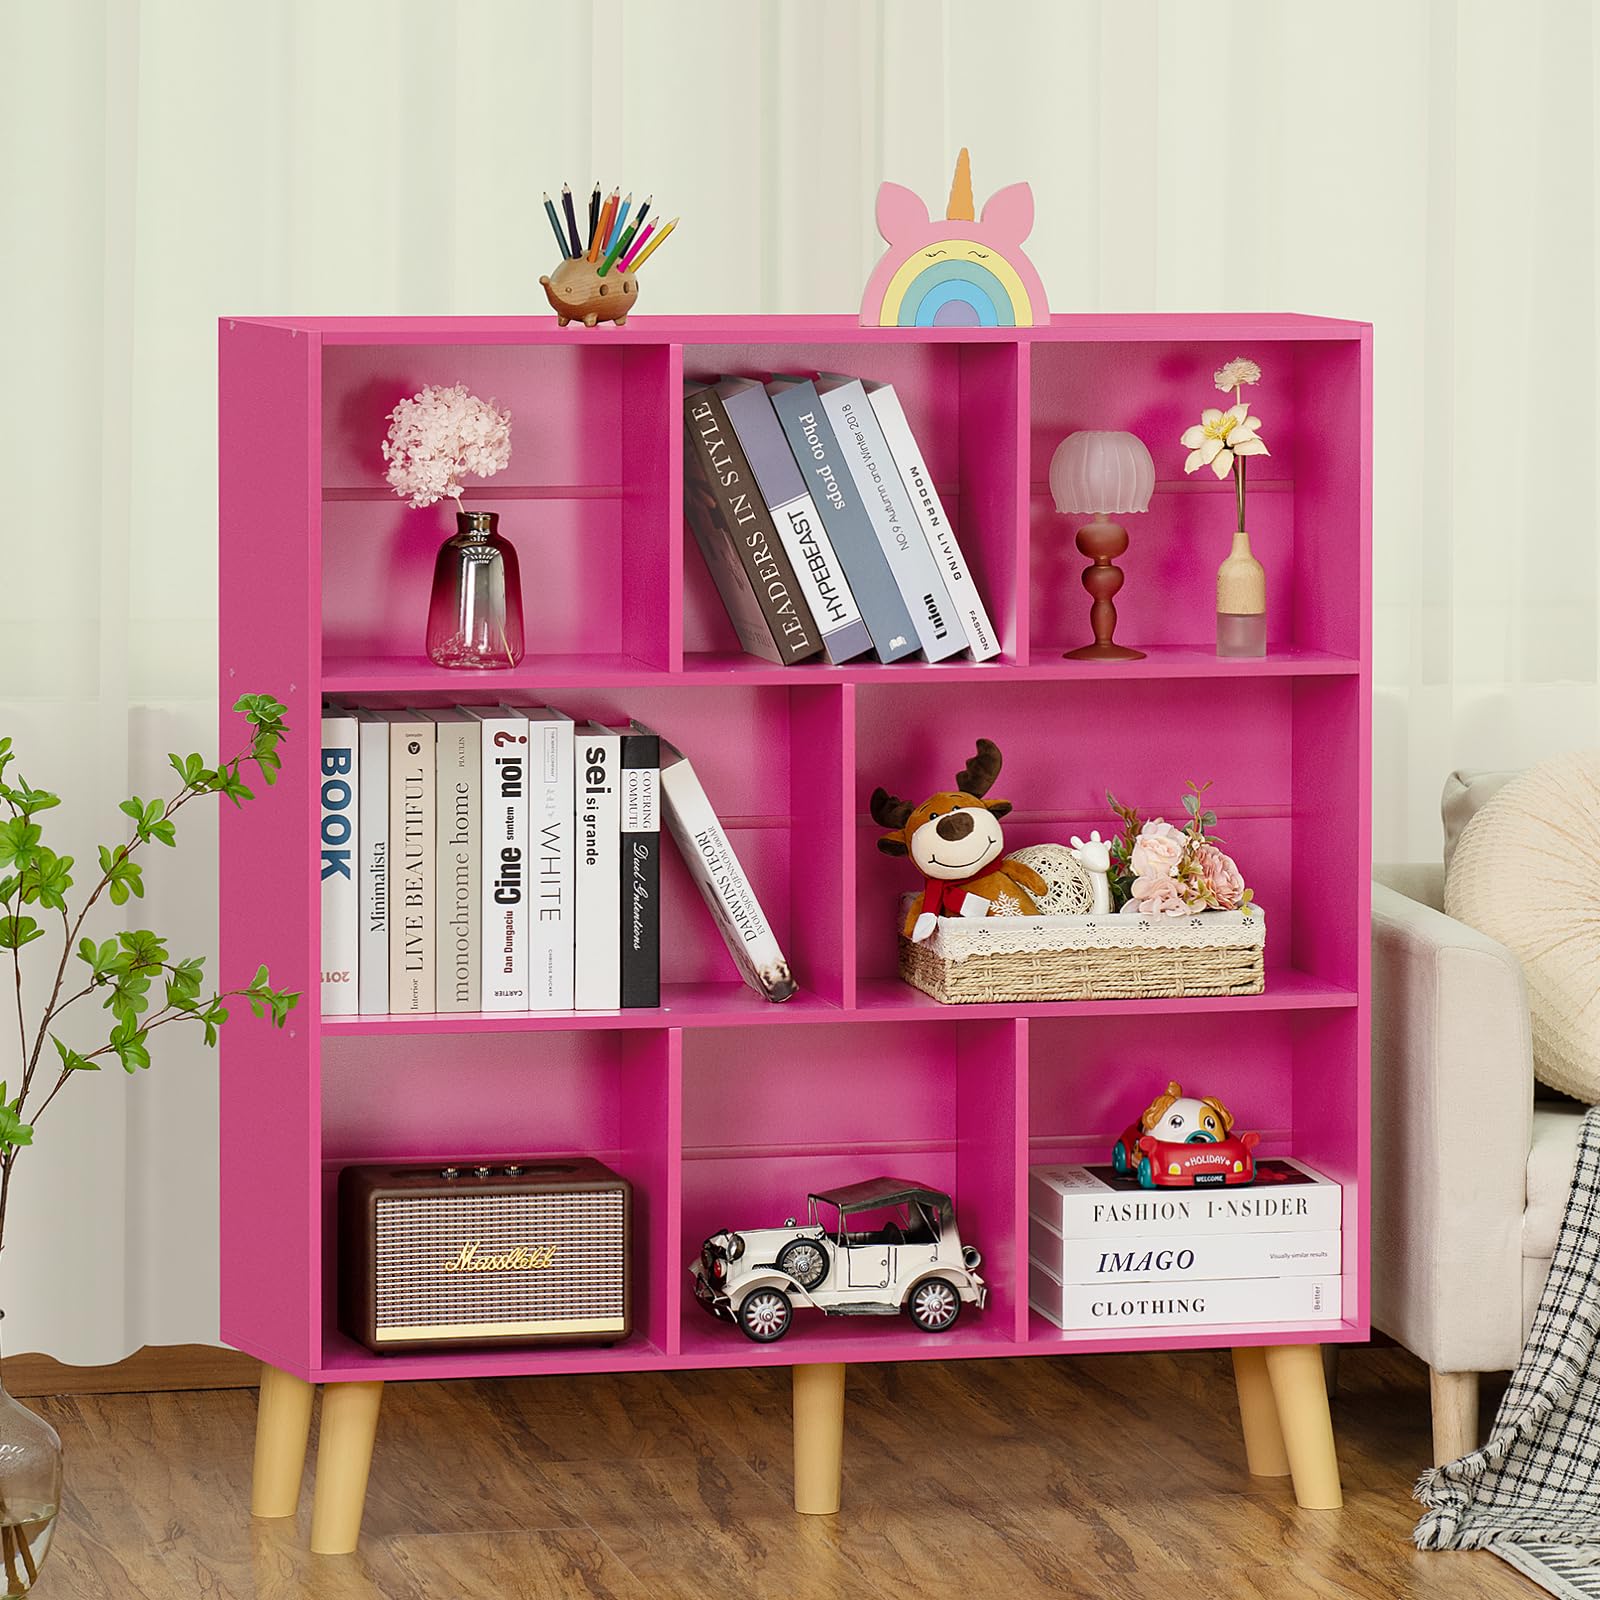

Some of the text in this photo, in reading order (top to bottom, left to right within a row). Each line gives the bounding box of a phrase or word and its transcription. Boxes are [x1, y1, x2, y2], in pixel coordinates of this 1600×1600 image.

[692, 400, 740, 487] STYLE
[798, 411, 846, 511] Photo props
[841, 404, 910, 551] NO.9 Autumn and Winter 2018
[729, 494, 758, 524] IN
[909, 466, 962, 580] MODERN LIVING
[745, 530, 811, 652] LEADERS
[787, 510, 847, 623] HYPEBEAST
[923, 593, 948, 640] Union
[969, 610, 990, 651] FASHION
[493, 730, 528, 748] ?
[495, 757, 522, 798] noi
[583, 746, 612, 866] sei si grande
[629, 771, 638, 829] COMMUTE
[642, 771, 652, 829] COVERING
[320, 748, 353, 882] BOOK
[370, 841, 387, 933] Minimalista
[404, 768, 426, 973] LIVE BEAUTIFUL
[449, 781, 470, 1003] monochrome home
[493, 847, 522, 905] Cine
[540, 822, 561, 922] WHITE
[694, 831, 757, 942] DARWINS TEORI
[719, 849, 743, 889] GJENNOM
[739, 889, 766, 935] EVOLUSJON
[503, 910, 516, 974] Dan Dungaciu
[409, 978, 420, 1011] Interior
[1189, 1154, 1227, 1166] HOLIDAY
[1195, 1175, 1224, 1183] WELCOME
[1092, 1201, 1191, 1223] FASHION
[1095, 1248, 1196, 1274] IMAGO
[1269, 1252, 1291, 1260] Visually
[1091, 1297, 1206, 1318] CLOTHING
[1313, 1286, 1322, 1310] Better
